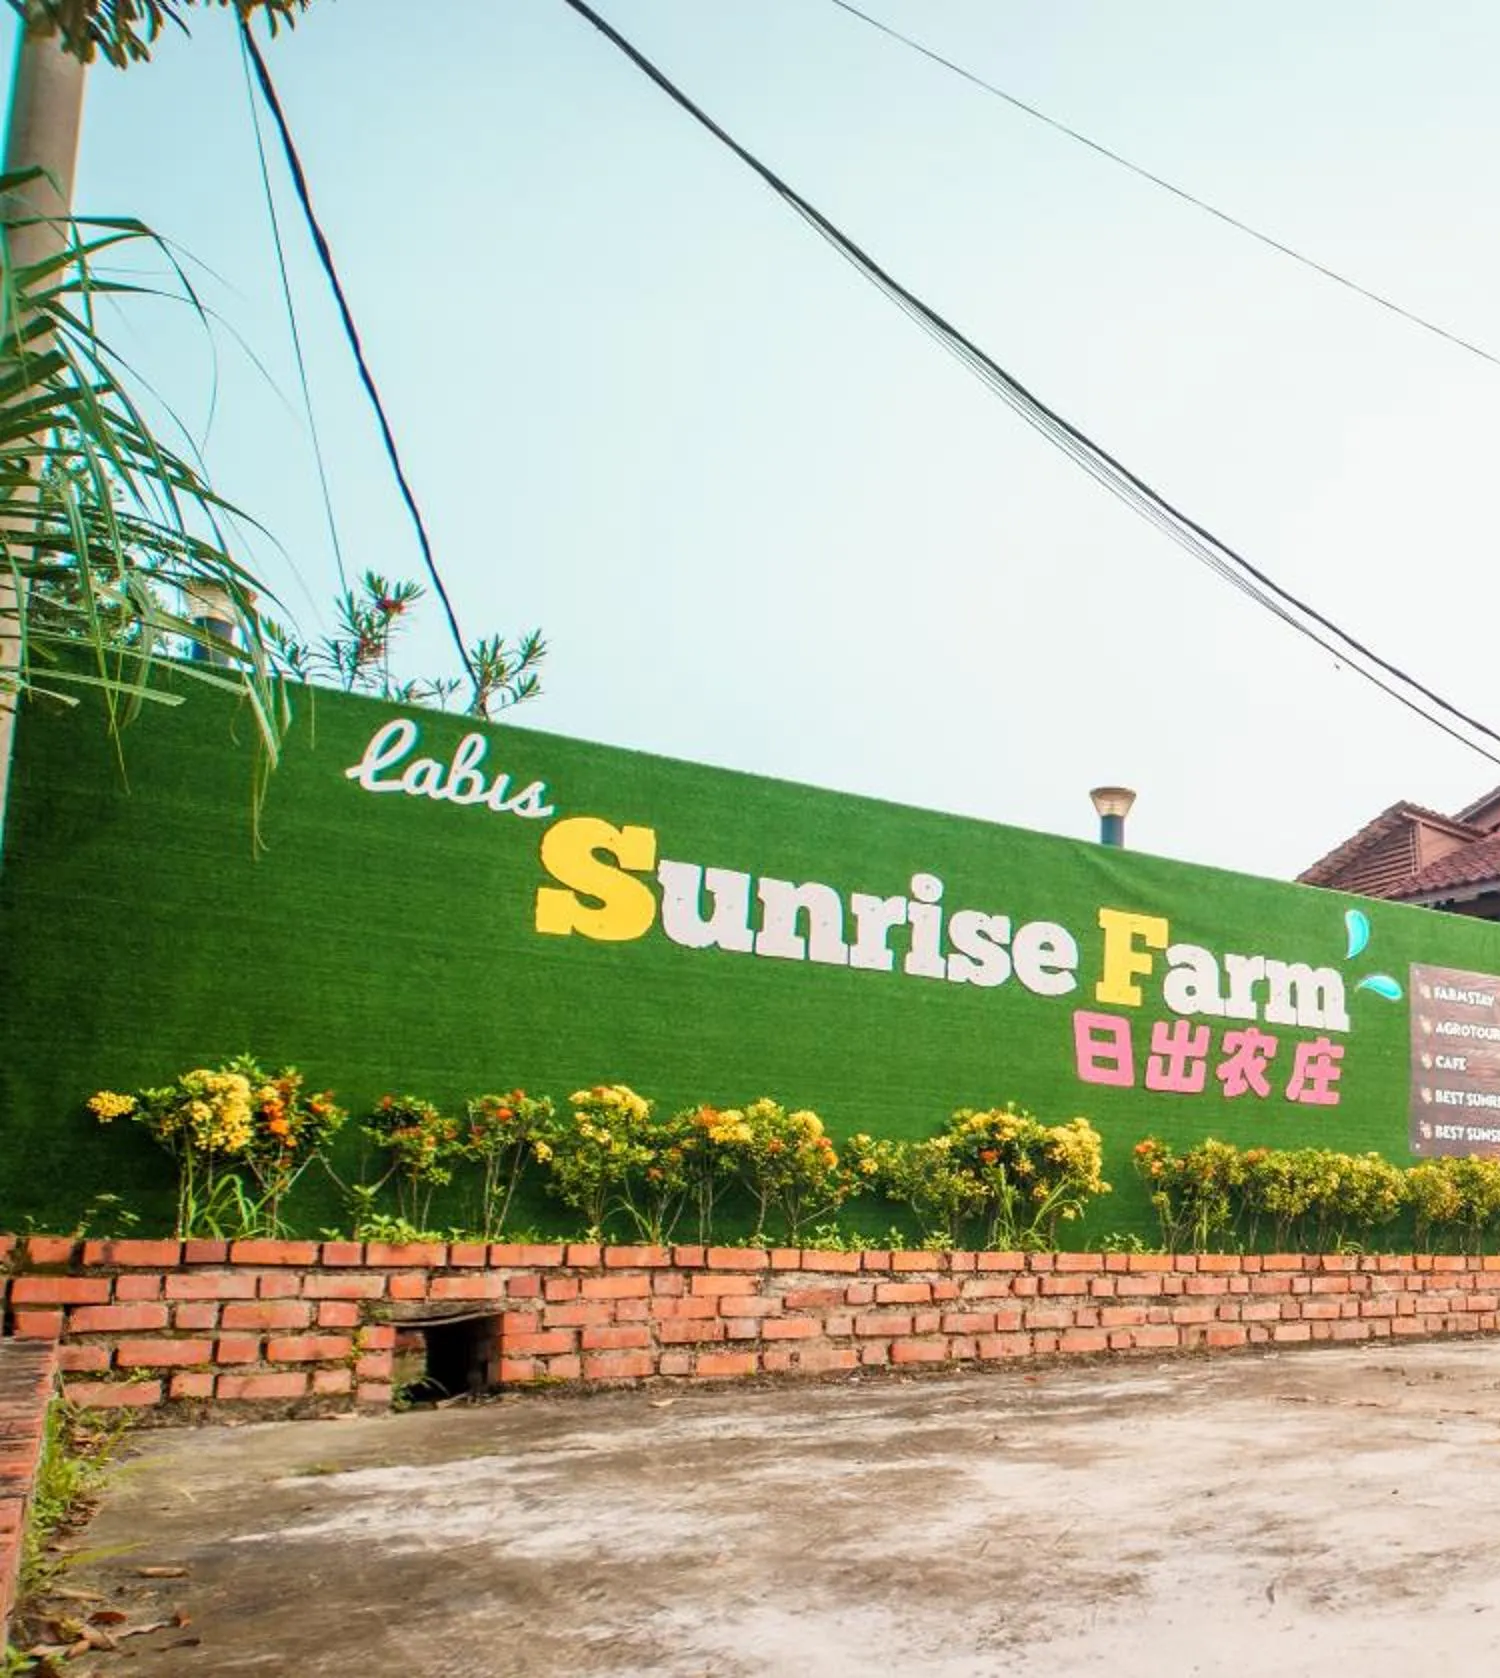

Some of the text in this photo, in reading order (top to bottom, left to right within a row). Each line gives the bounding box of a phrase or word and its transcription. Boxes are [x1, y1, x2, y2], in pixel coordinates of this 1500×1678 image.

[535, 817, 1351, 1032] Sunrise Farm
[1433, 986, 1495, 1007] FARMSTAY
[1072, 1009, 1345, 1105] 日出农庄
[1435, 1055, 1467, 1071] CAFE
[1435, 1089, 1464, 1104] BEST
[1435, 1124, 1464, 1140] BEST
